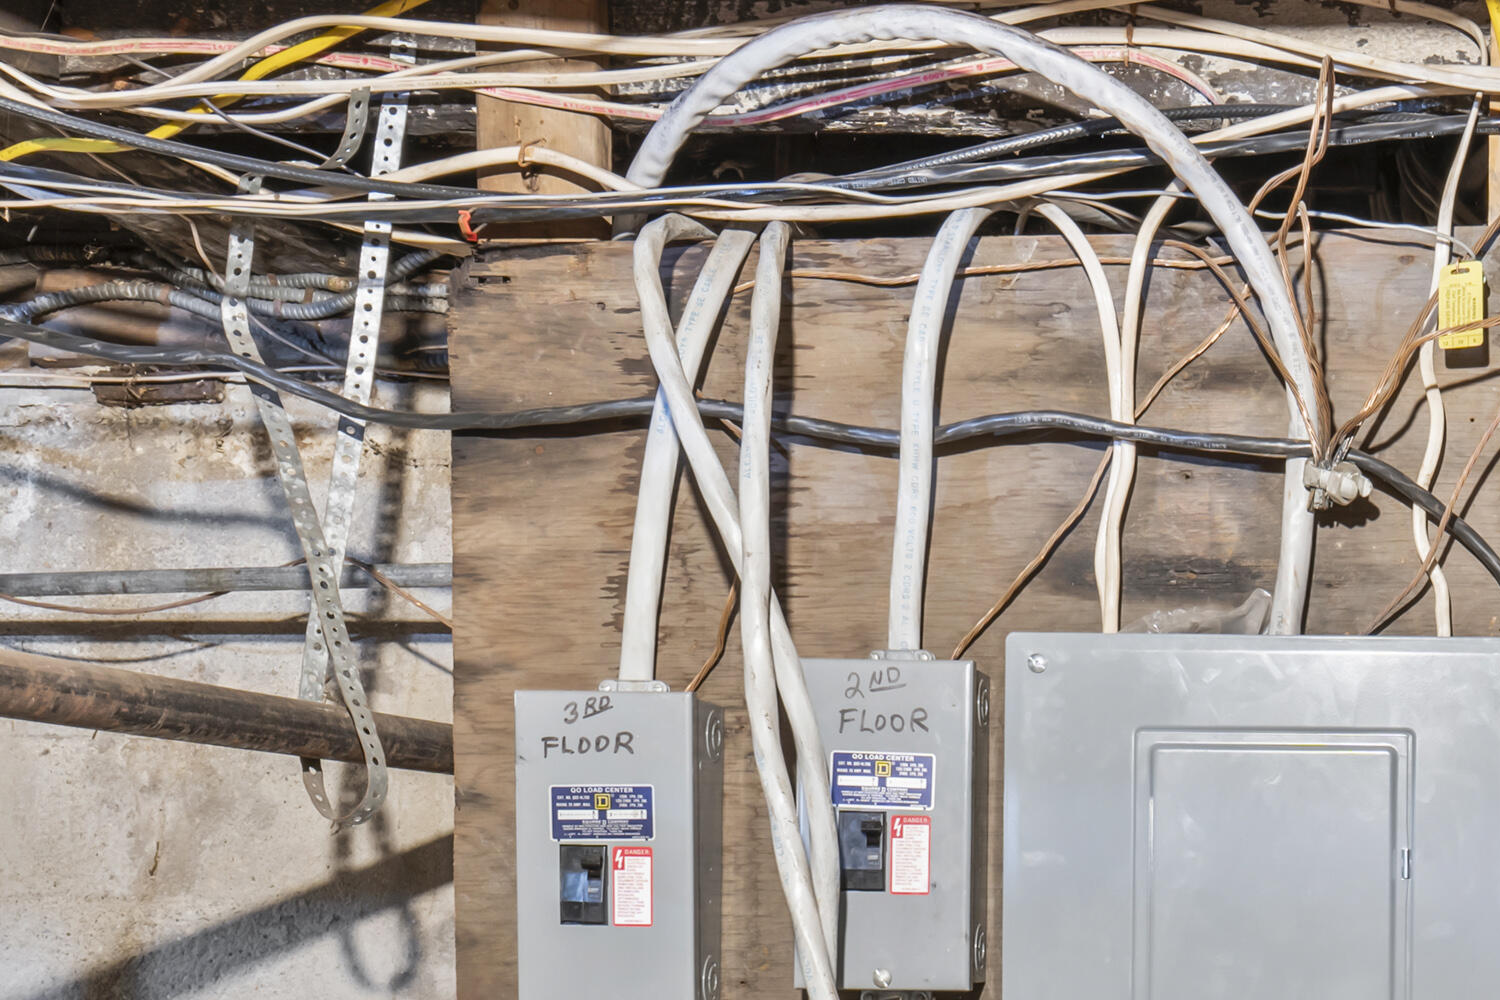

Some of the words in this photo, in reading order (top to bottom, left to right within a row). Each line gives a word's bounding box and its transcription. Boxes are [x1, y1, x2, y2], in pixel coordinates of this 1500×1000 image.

[846, 667, 908, 699] 2ND
[563, 695, 614, 725] 3RD
[838, 707, 929, 735] FLOOR
[541, 731, 634, 758] FLOOR
[877, 762, 890, 775] D
[596, 795, 609, 808] D
